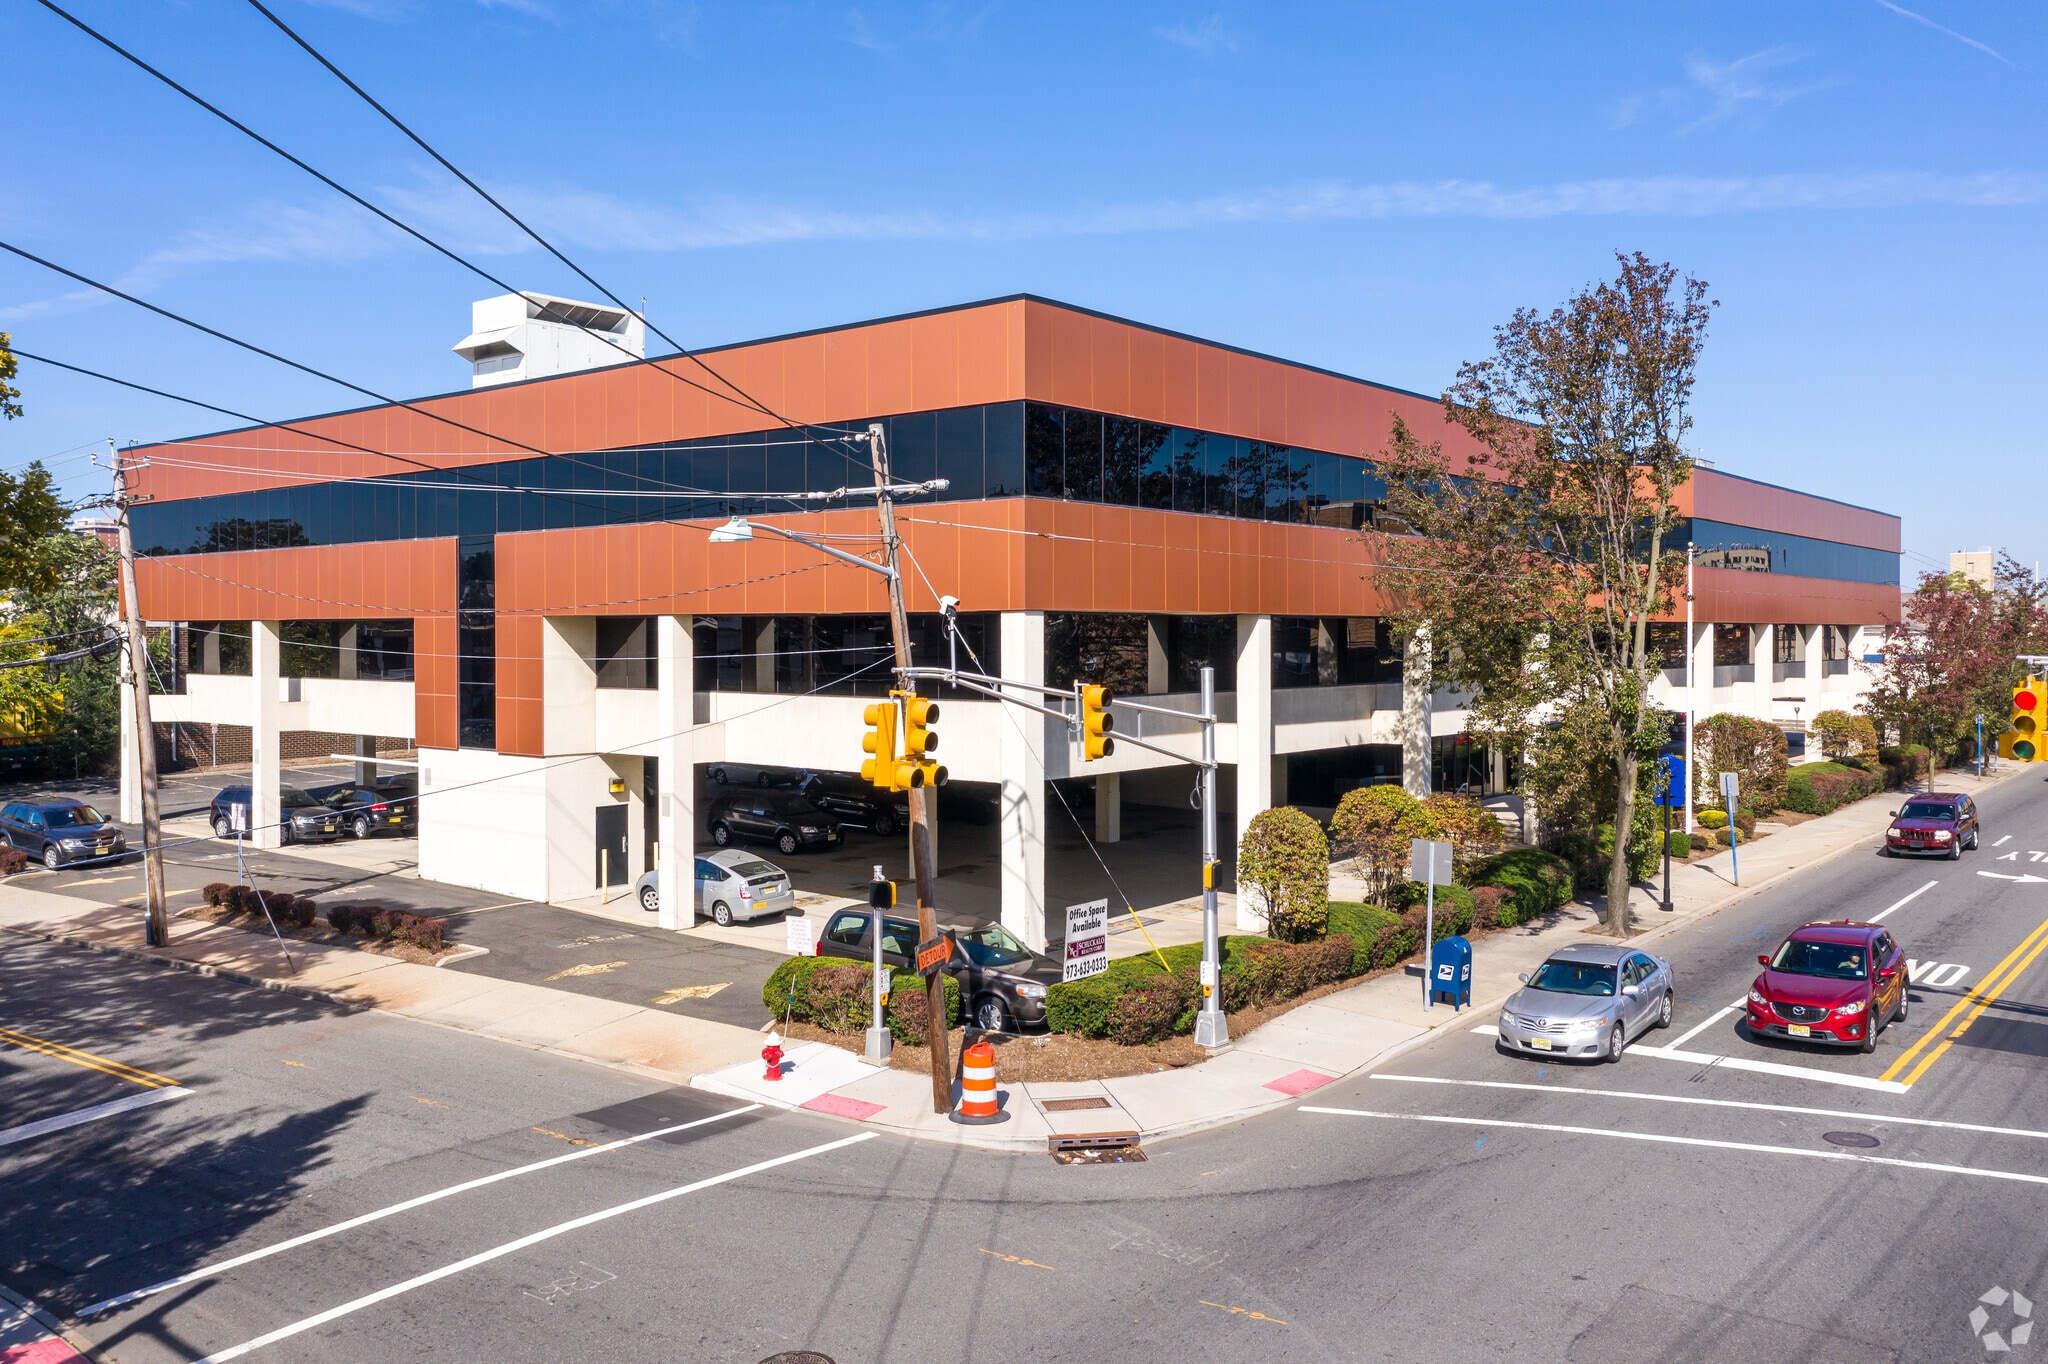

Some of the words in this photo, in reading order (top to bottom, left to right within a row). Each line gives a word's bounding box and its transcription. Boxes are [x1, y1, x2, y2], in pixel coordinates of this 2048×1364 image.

[1996, 850, 2048, 862] LY
[1069, 908, 1087, 920] Office
[1088, 905, 1105, 917] Space
[1072, 918, 1101, 933] Available
[921, 945, 946, 966] DETOUR
[1066, 956, 1107, 979] 973-633-0333
